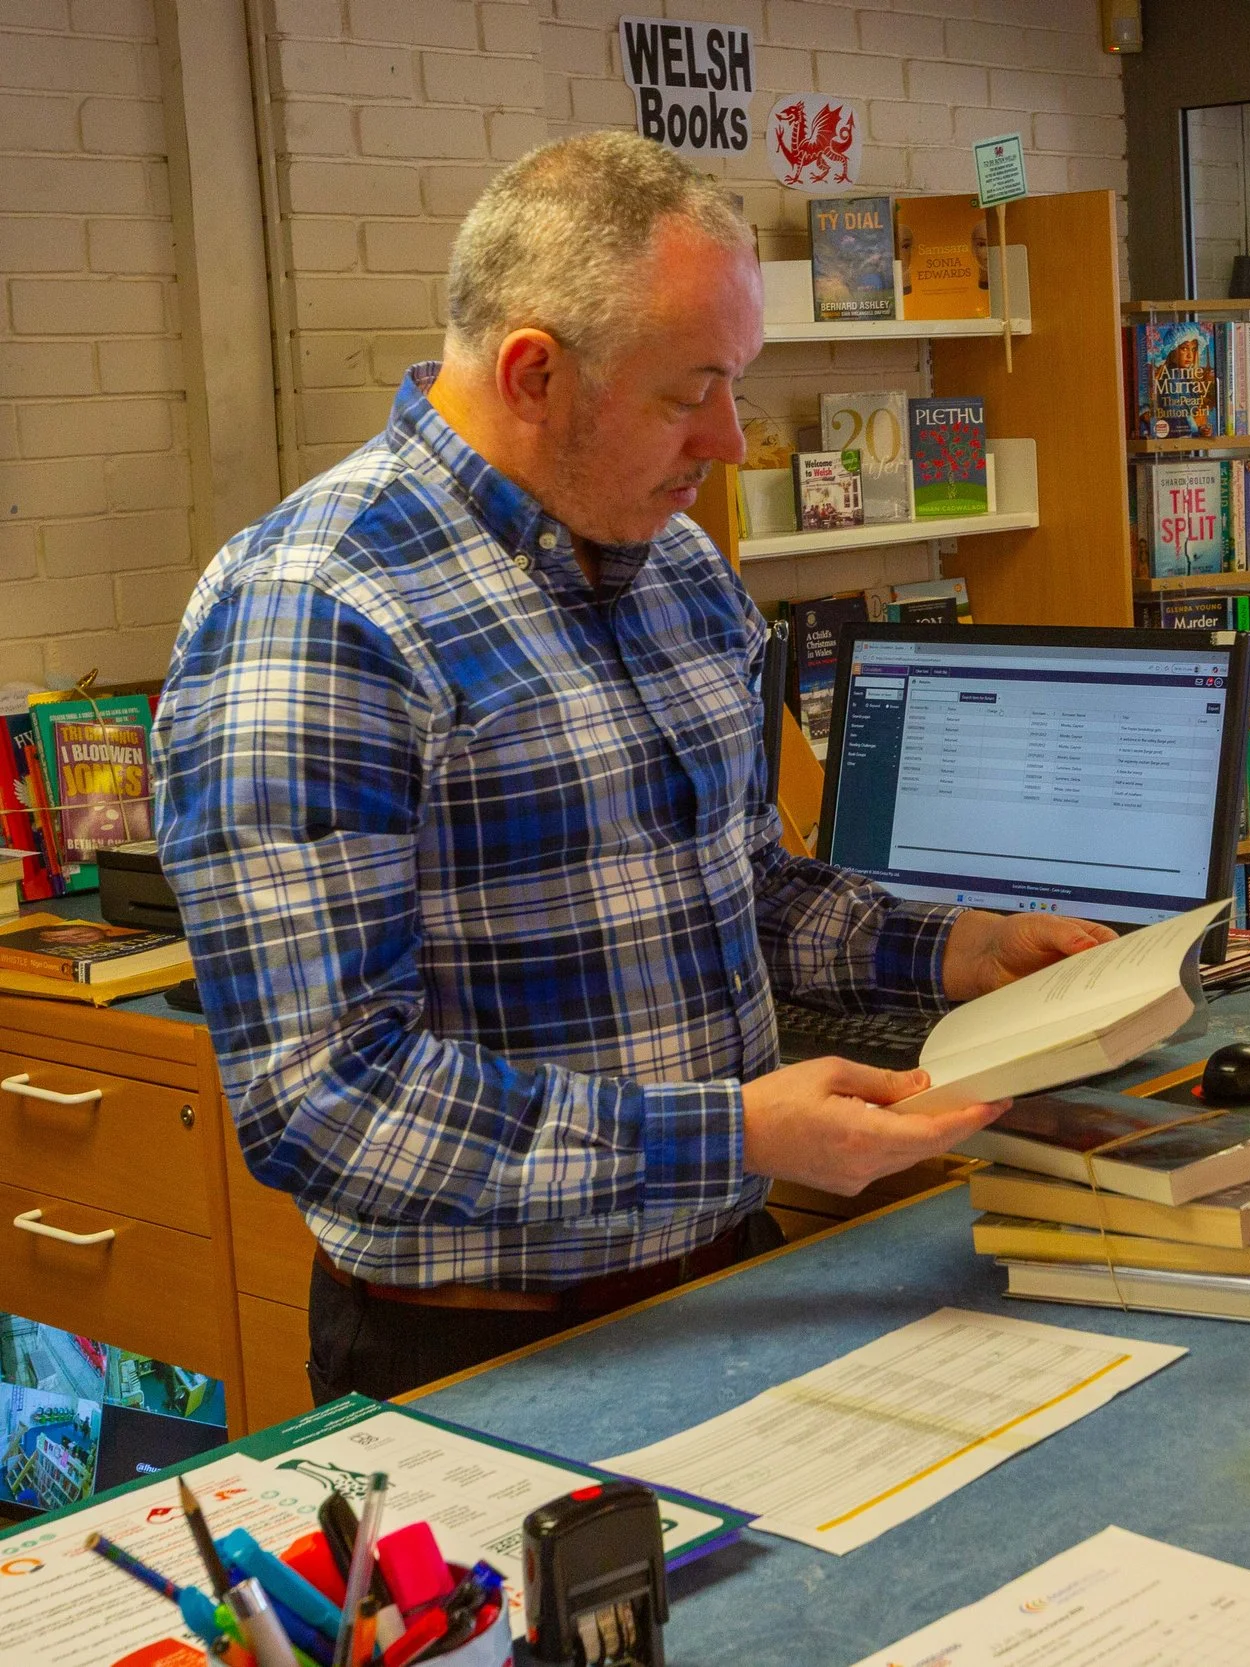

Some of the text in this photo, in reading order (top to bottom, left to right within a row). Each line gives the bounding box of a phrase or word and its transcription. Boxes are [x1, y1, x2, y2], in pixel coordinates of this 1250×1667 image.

[624, 21, 752, 93] WELSH
[639, 87, 749, 151] Books
[844, 212, 883, 230] DIAL
[926, 258, 962, 269] SONIA
[917, 268, 971, 281] EDWARDS
[821, 300, 890, 312] BERNARD ASHLEY
[1160, 366, 1204, 380] Annie
[1155, 380, 1212, 398] Murray
[915, 408, 984, 425] PLETHU
[1157, 406, 1210, 419] Button Girl
[804, 460, 833, 468] Welcome
[813, 468, 833, 477] Welsh
[1170, 488, 1206, 514] THE
[1162, 515, 1217, 545] SPLIT
[1195, 603, 1222, 611] YOUNG
[806, 631, 832, 642] A Child's
[806, 639, 837, 650] Christmas
[807, 649, 833, 659] in Wales
[60, 725, 84, 743] TRI
[61, 744, 144, 765] I BLODWEN
[62, 763, 143, 798] JONES
